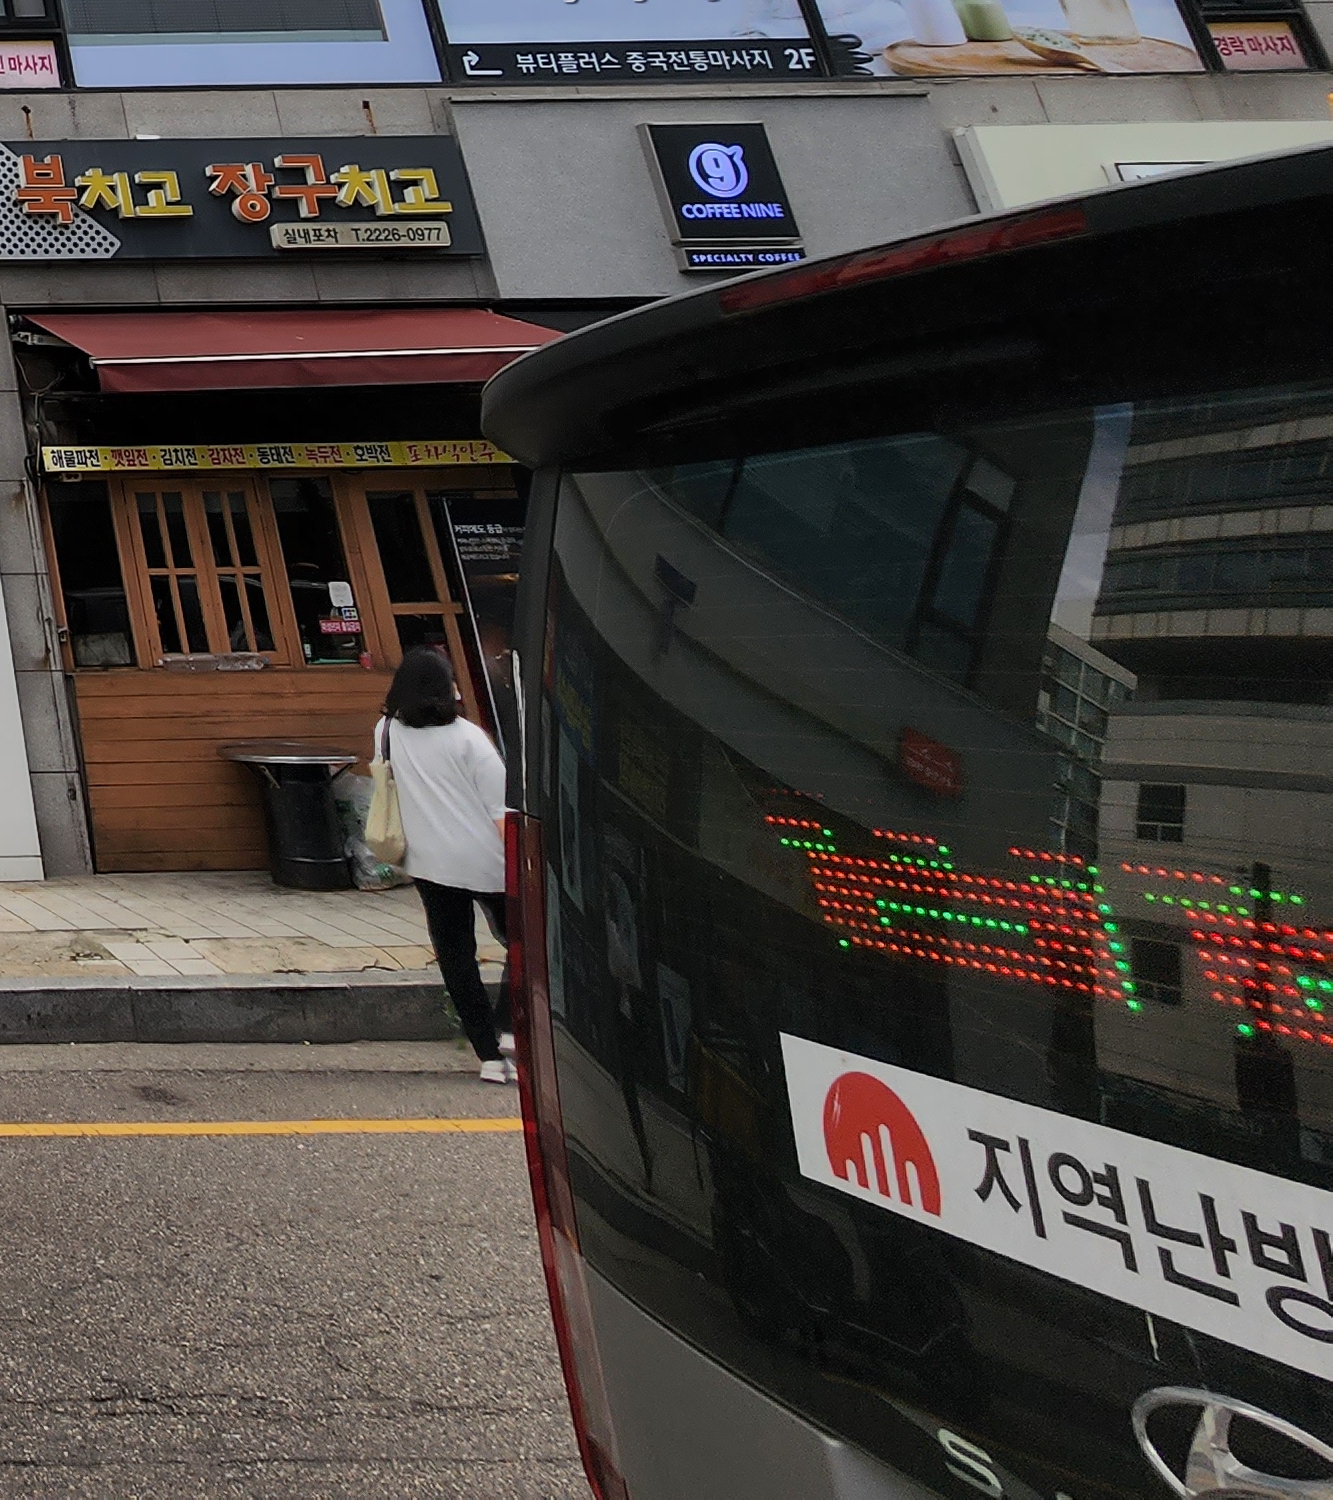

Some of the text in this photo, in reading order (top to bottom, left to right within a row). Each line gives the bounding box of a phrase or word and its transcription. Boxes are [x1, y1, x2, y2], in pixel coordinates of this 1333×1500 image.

[1247, 34, 1297, 56] 마사지
[7, 54, 54, 75] 마사지
[515, 48, 818, 76] 뷰티플러스 중국전통마사지 2F
[14, 153, 454, 227] 북치고 장구치고
[681, 203, 785, 219] COFFEE NINE
[283, 227, 443, 246] 실내포차 T.2226-0977
[692, 253, 801, 263] SPECIALTY COFFEE
[160, 447, 199, 466] 김치전
[257, 445, 296, 464] 동태전
[305, 445, 344, 464] 녹두전
[352, 444, 393, 463] 호박전
